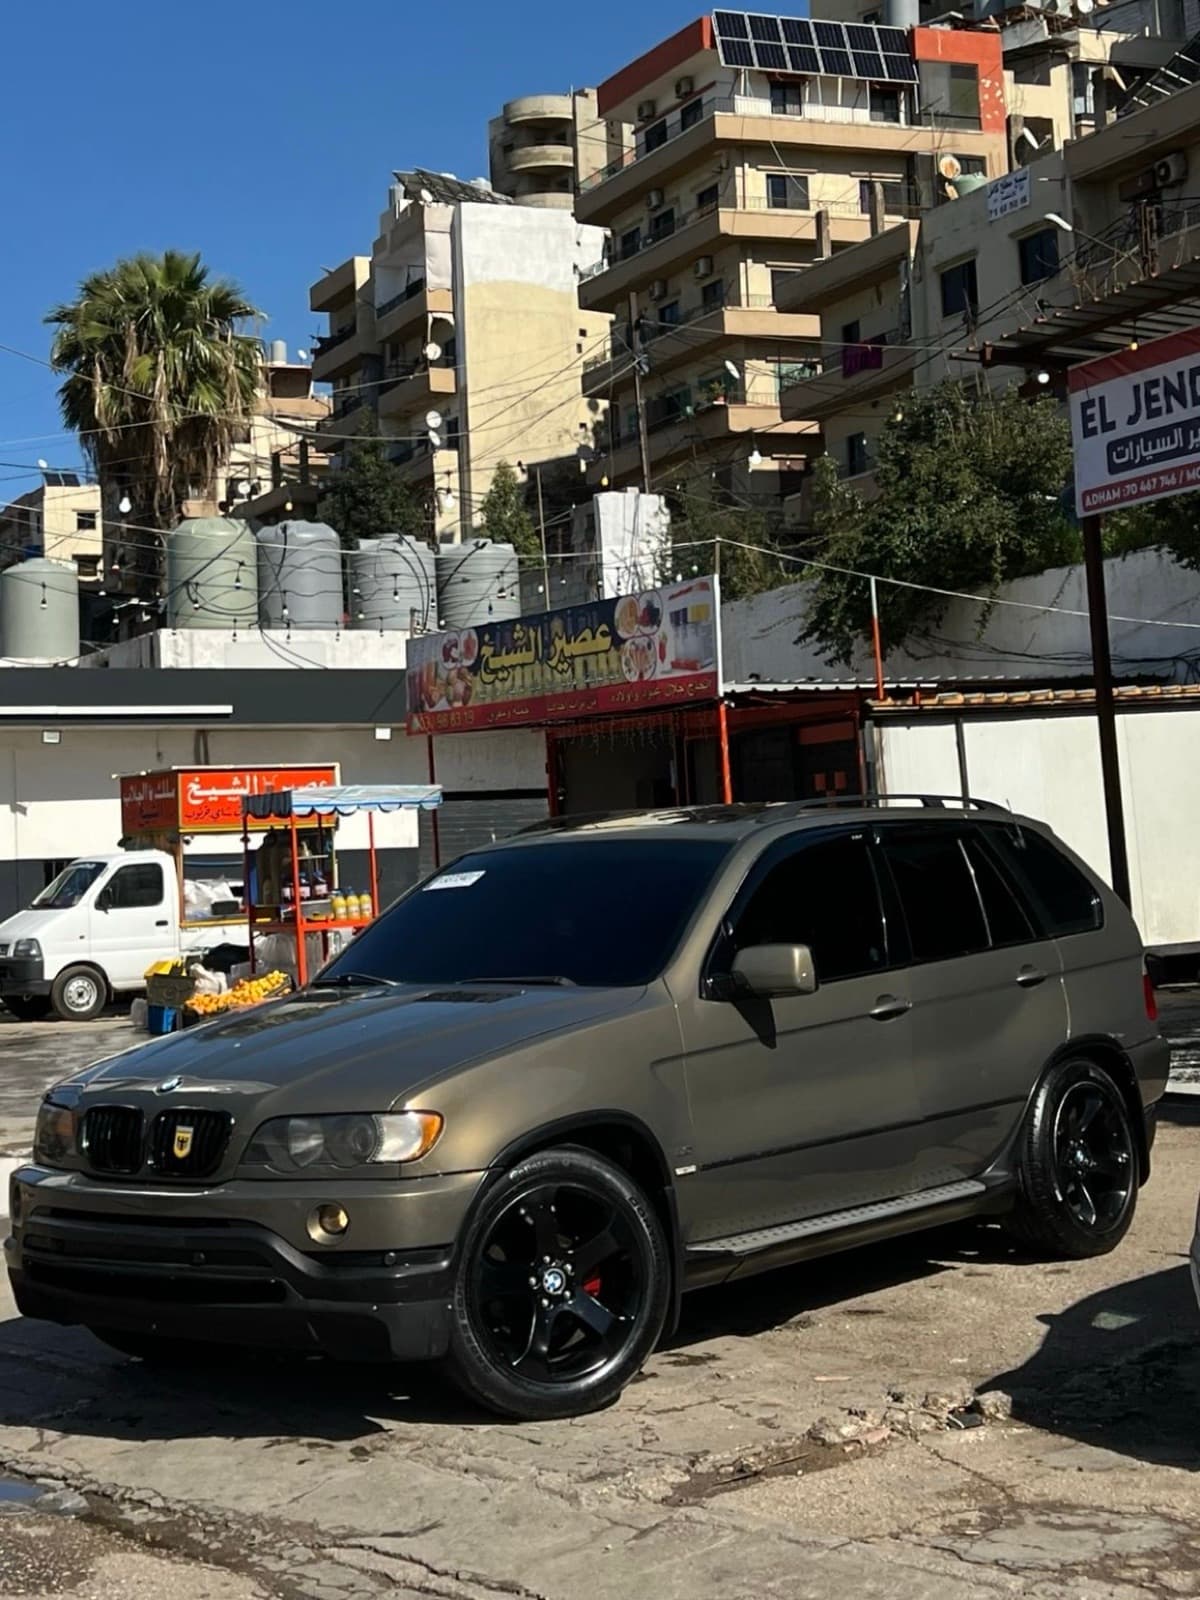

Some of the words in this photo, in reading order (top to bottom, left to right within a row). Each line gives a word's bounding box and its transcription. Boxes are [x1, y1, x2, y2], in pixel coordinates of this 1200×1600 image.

[1080, 395, 1117, 439] EL
[1112, 427, 1184, 464] السيارات
[1085, 487, 1121, 507] ADHAM
[480, 623, 543, 685] الشيخ
[549, 622, 614, 673] عصير
[186, 773, 258, 805] الشيخ
